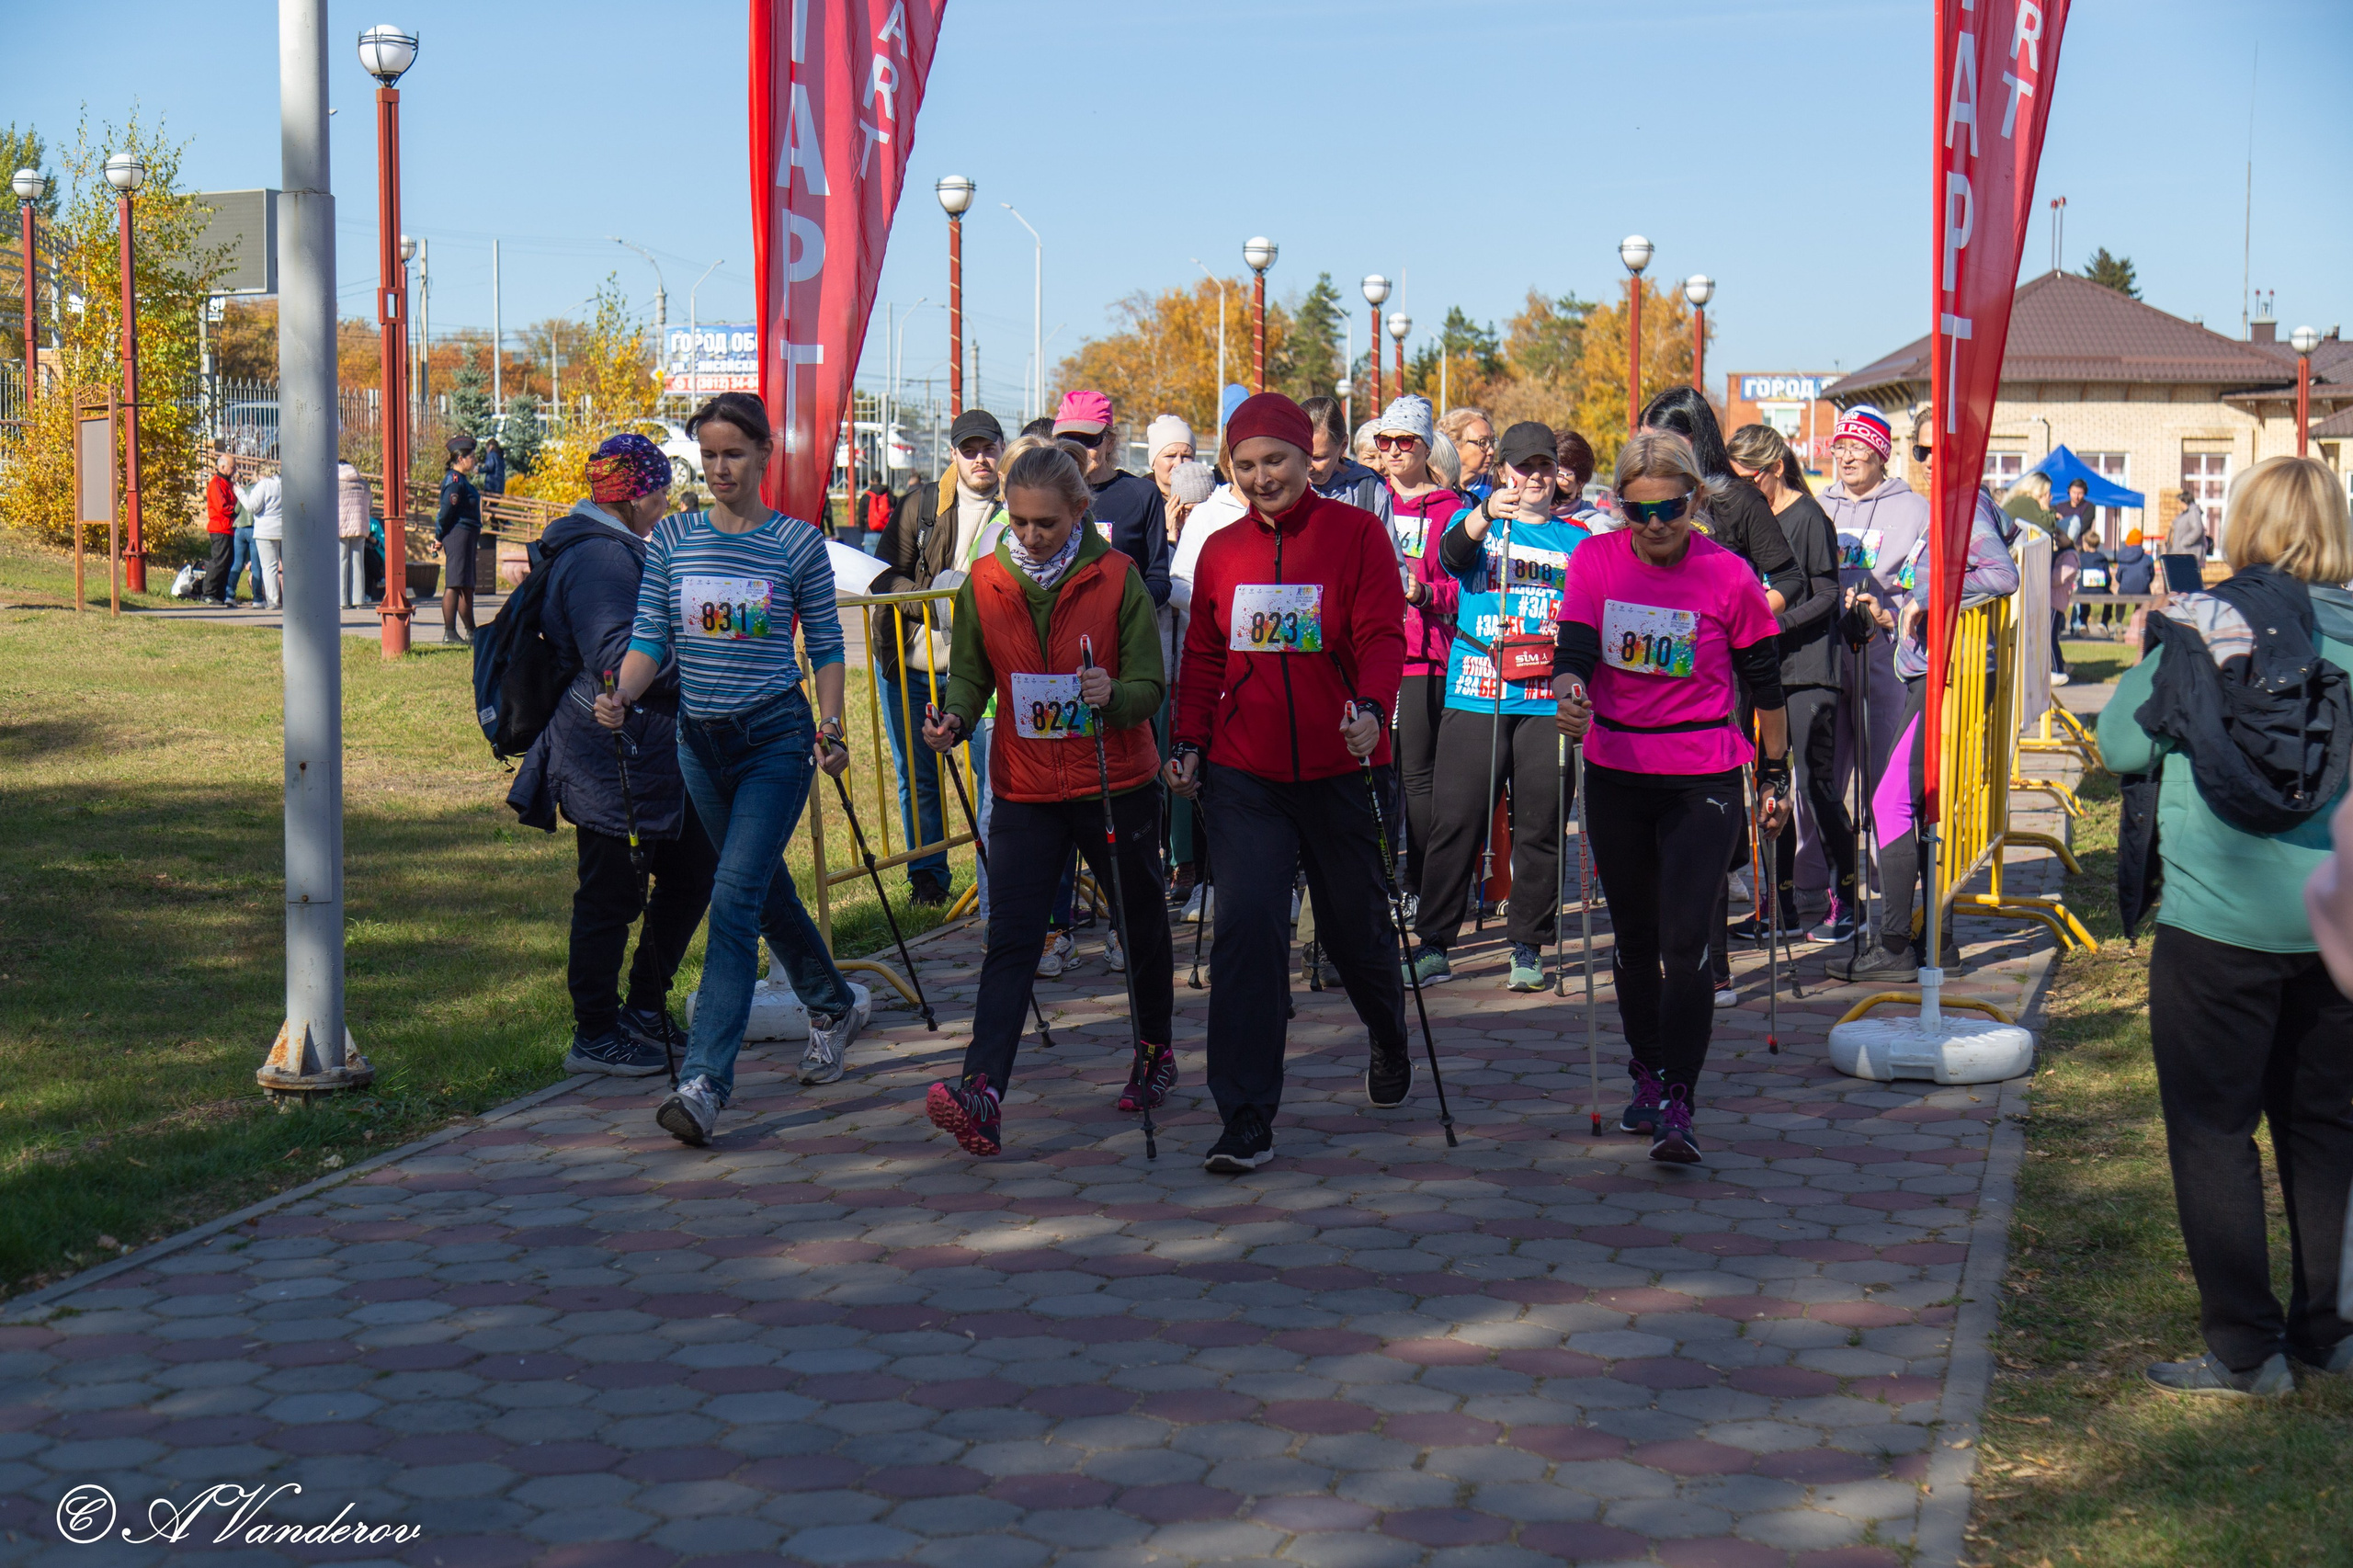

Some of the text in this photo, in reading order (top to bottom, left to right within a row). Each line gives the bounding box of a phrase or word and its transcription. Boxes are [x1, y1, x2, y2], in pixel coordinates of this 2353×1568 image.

[731, 332, 758, 353] ОБ
[1745, 379, 1814, 399] ГОРОД
[1515, 558, 1553, 582] 808
[702, 601, 746, 632] 831
[1518, 595, 1563, 621] #ЗАБ
[1251, 611, 1298, 643] 823
[1621, 631, 1672, 667] 810
[1032, 700, 1080, 731] 822
[1579, 830, 1590, 914] PASSION
